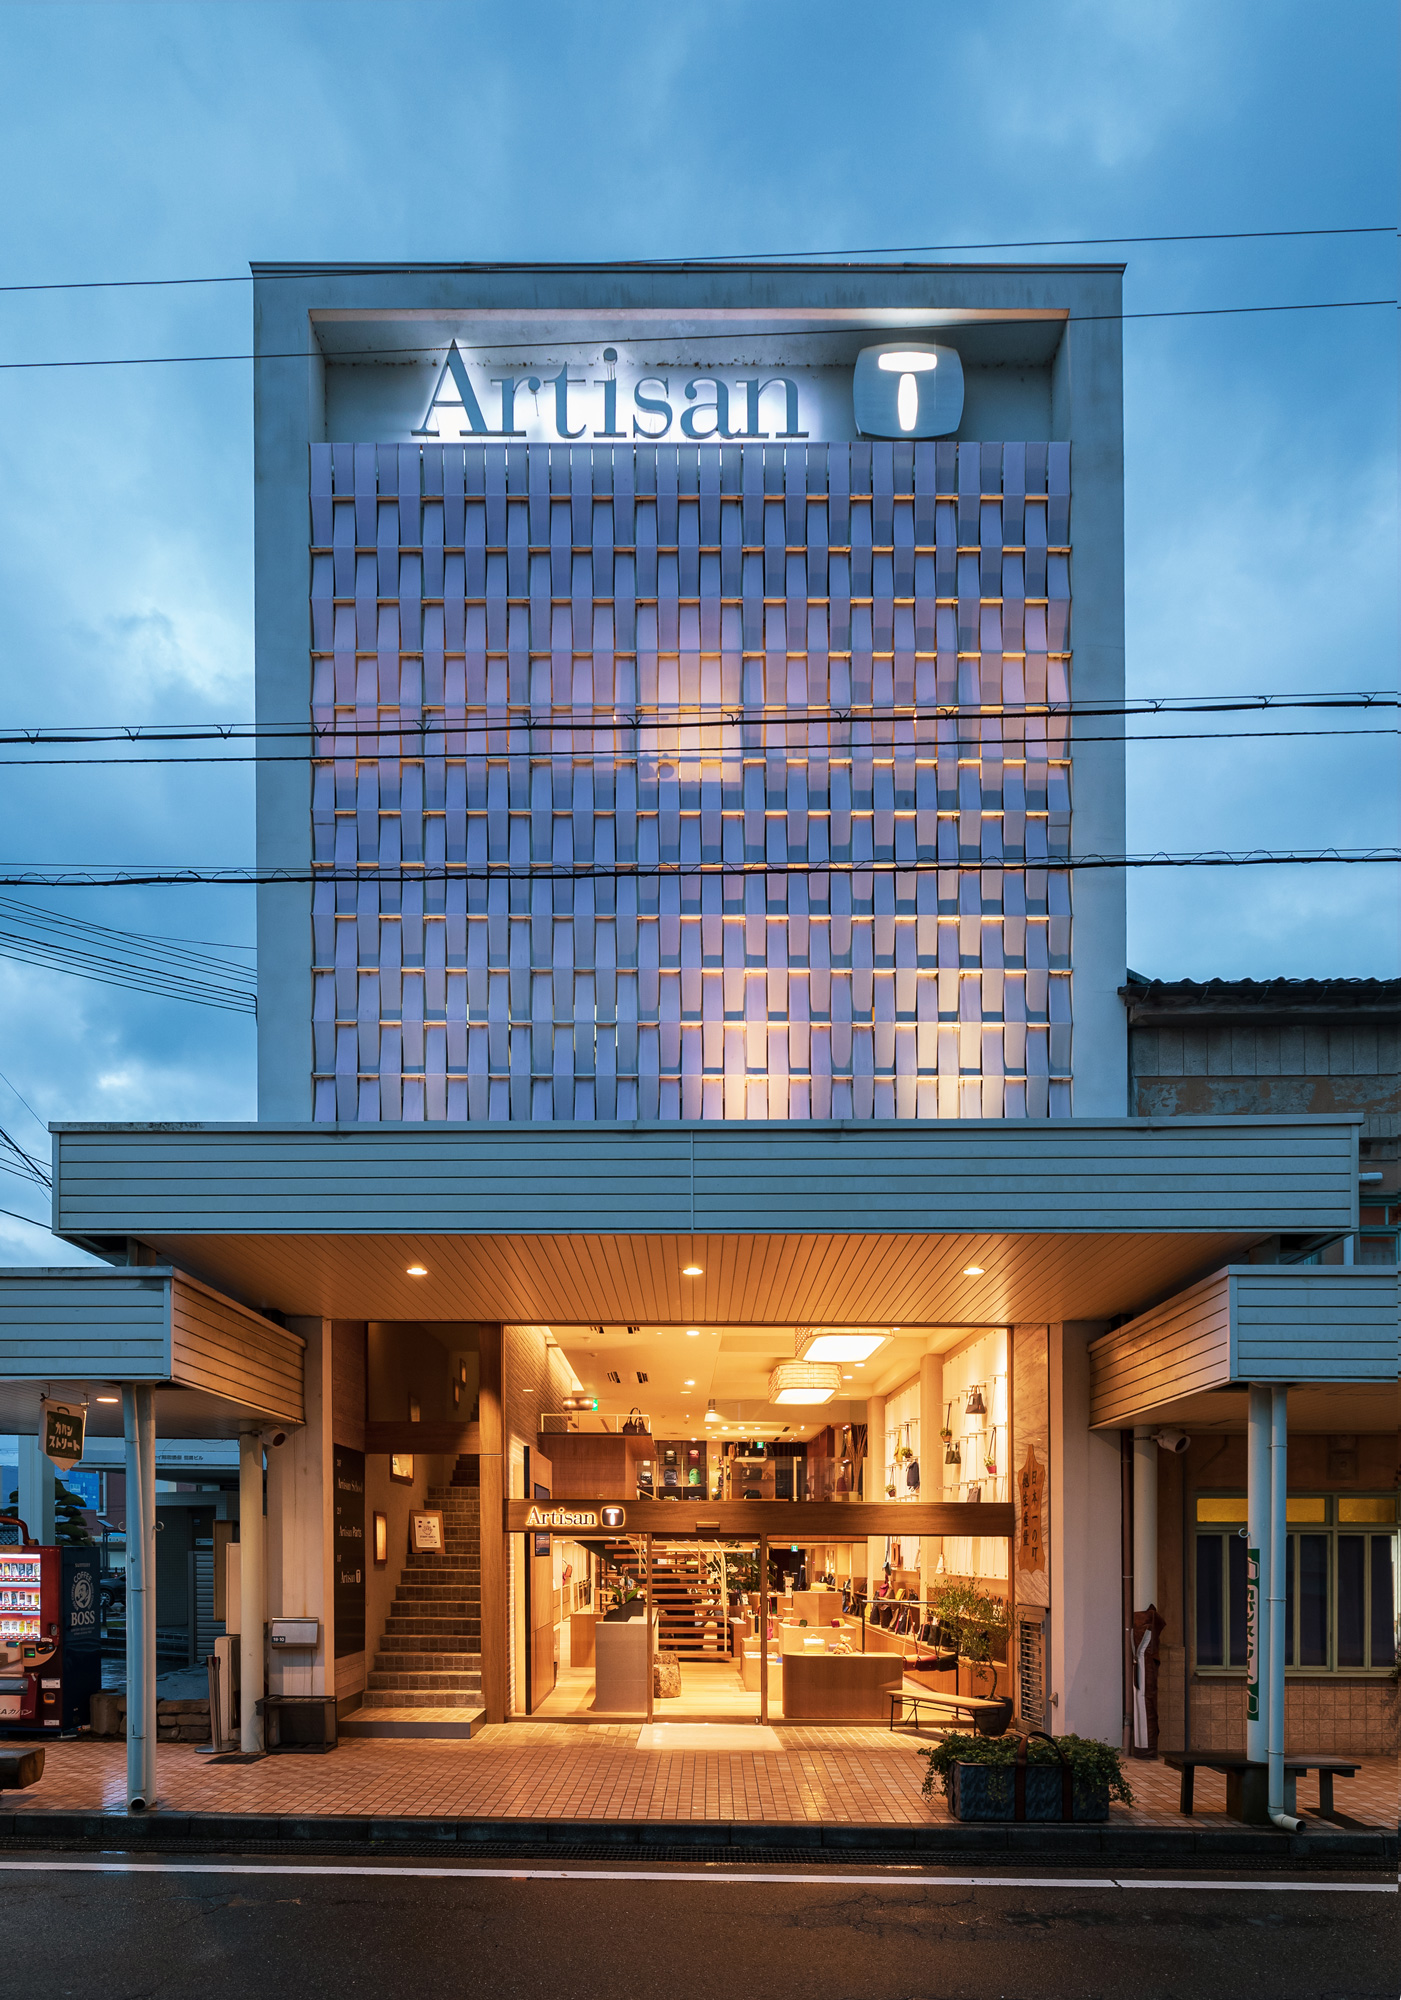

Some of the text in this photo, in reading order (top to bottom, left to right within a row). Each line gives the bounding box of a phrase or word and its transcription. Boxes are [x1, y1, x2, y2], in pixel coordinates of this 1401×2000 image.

[410, 338, 810, 440] Artisan
[48, 1435, 81, 1452] ストリート
[526, 1506, 597, 1526] Artisan
[73, 1571, 93, 1583] COFFEE
[70, 1610, 95, 1626] BOSS
